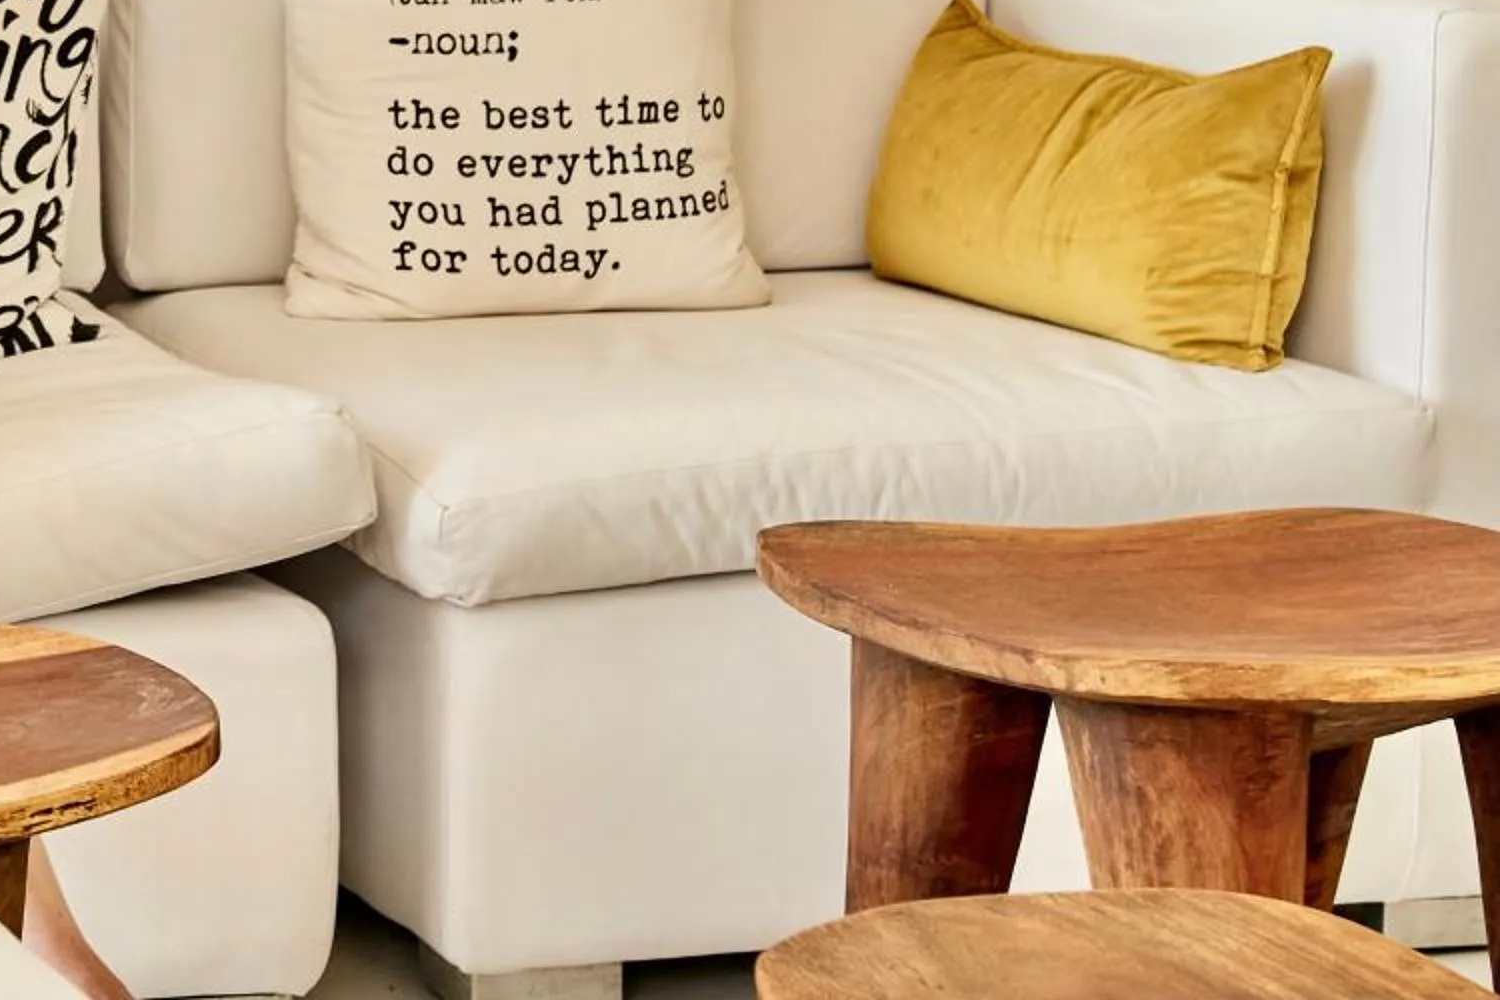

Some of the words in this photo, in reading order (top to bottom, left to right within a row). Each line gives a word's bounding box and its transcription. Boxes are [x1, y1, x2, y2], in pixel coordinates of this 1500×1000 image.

[388, 30, 519, 62] -noun;
[387, 98, 461, 131] the
[481, 98, 573, 131] best
[595, 94, 680, 129] time
[697, 92, 725, 122] to
[387, 145, 434, 177] do
[457, 142, 695, 185] everything
[388, 199, 466, 232] you
[486, 195, 563, 228] had
[585, 180, 730, 232] planned
[391, 240, 468, 274] for
[489, 243, 621, 280] today.
